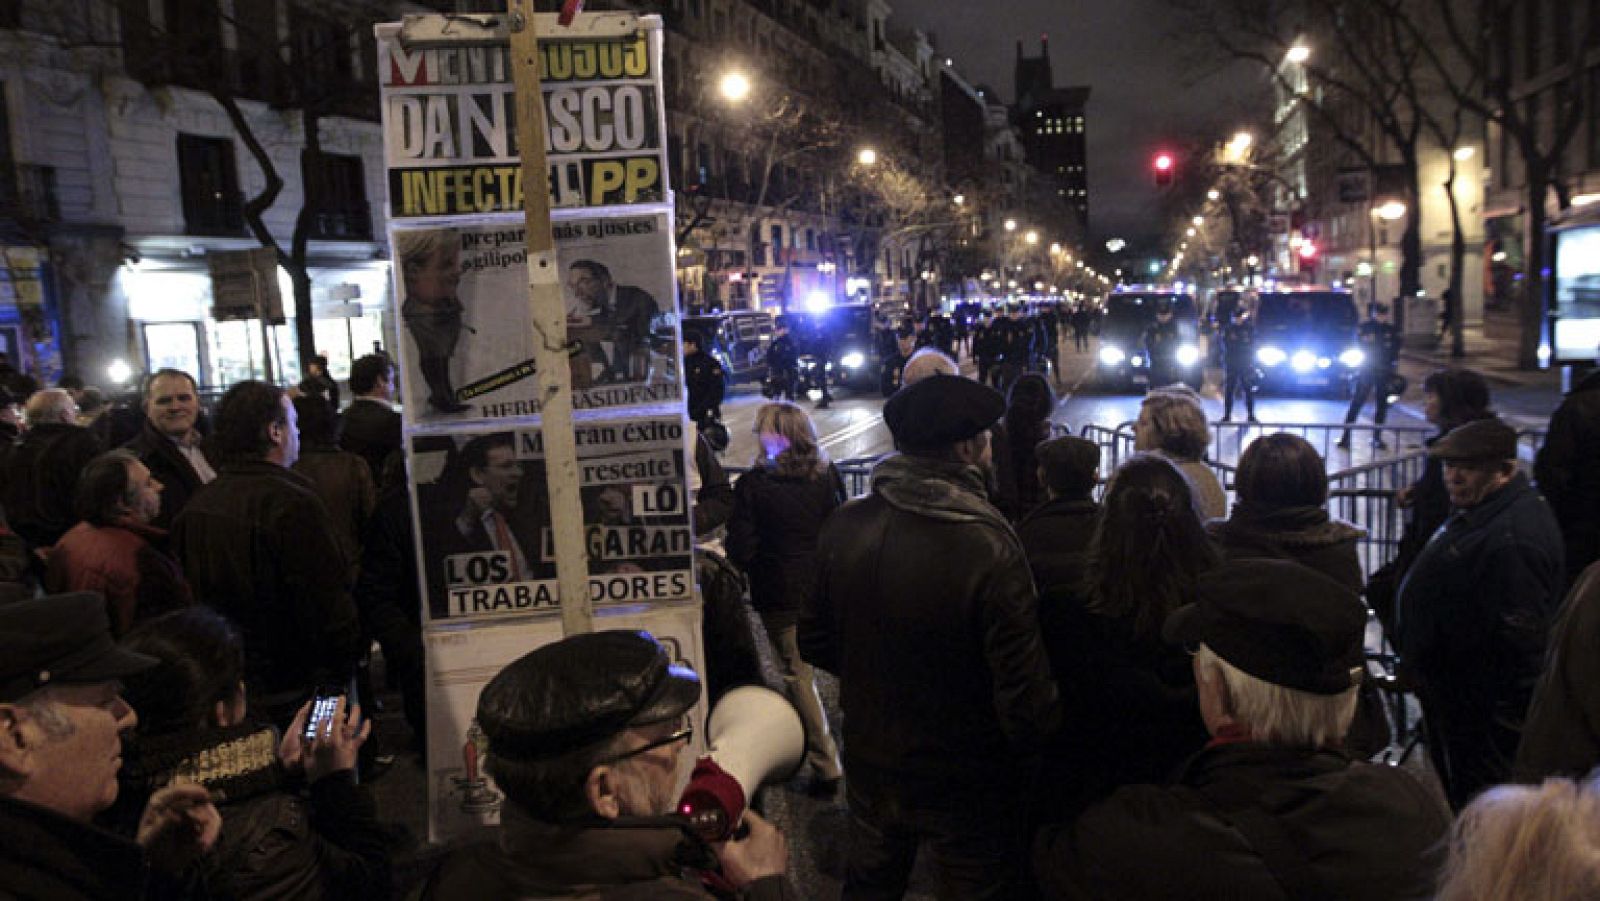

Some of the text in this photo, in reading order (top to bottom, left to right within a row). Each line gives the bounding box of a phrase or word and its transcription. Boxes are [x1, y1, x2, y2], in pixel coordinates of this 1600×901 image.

[394, 92, 508, 159] DAN
[591, 157, 659, 206] PP
[575, 426, 617, 445] ran
[622, 421, 682, 444] éxito
[583, 458, 672, 483] rescate
[448, 554, 509, 584] LOS
[452, 573, 687, 613] TRABADORES
